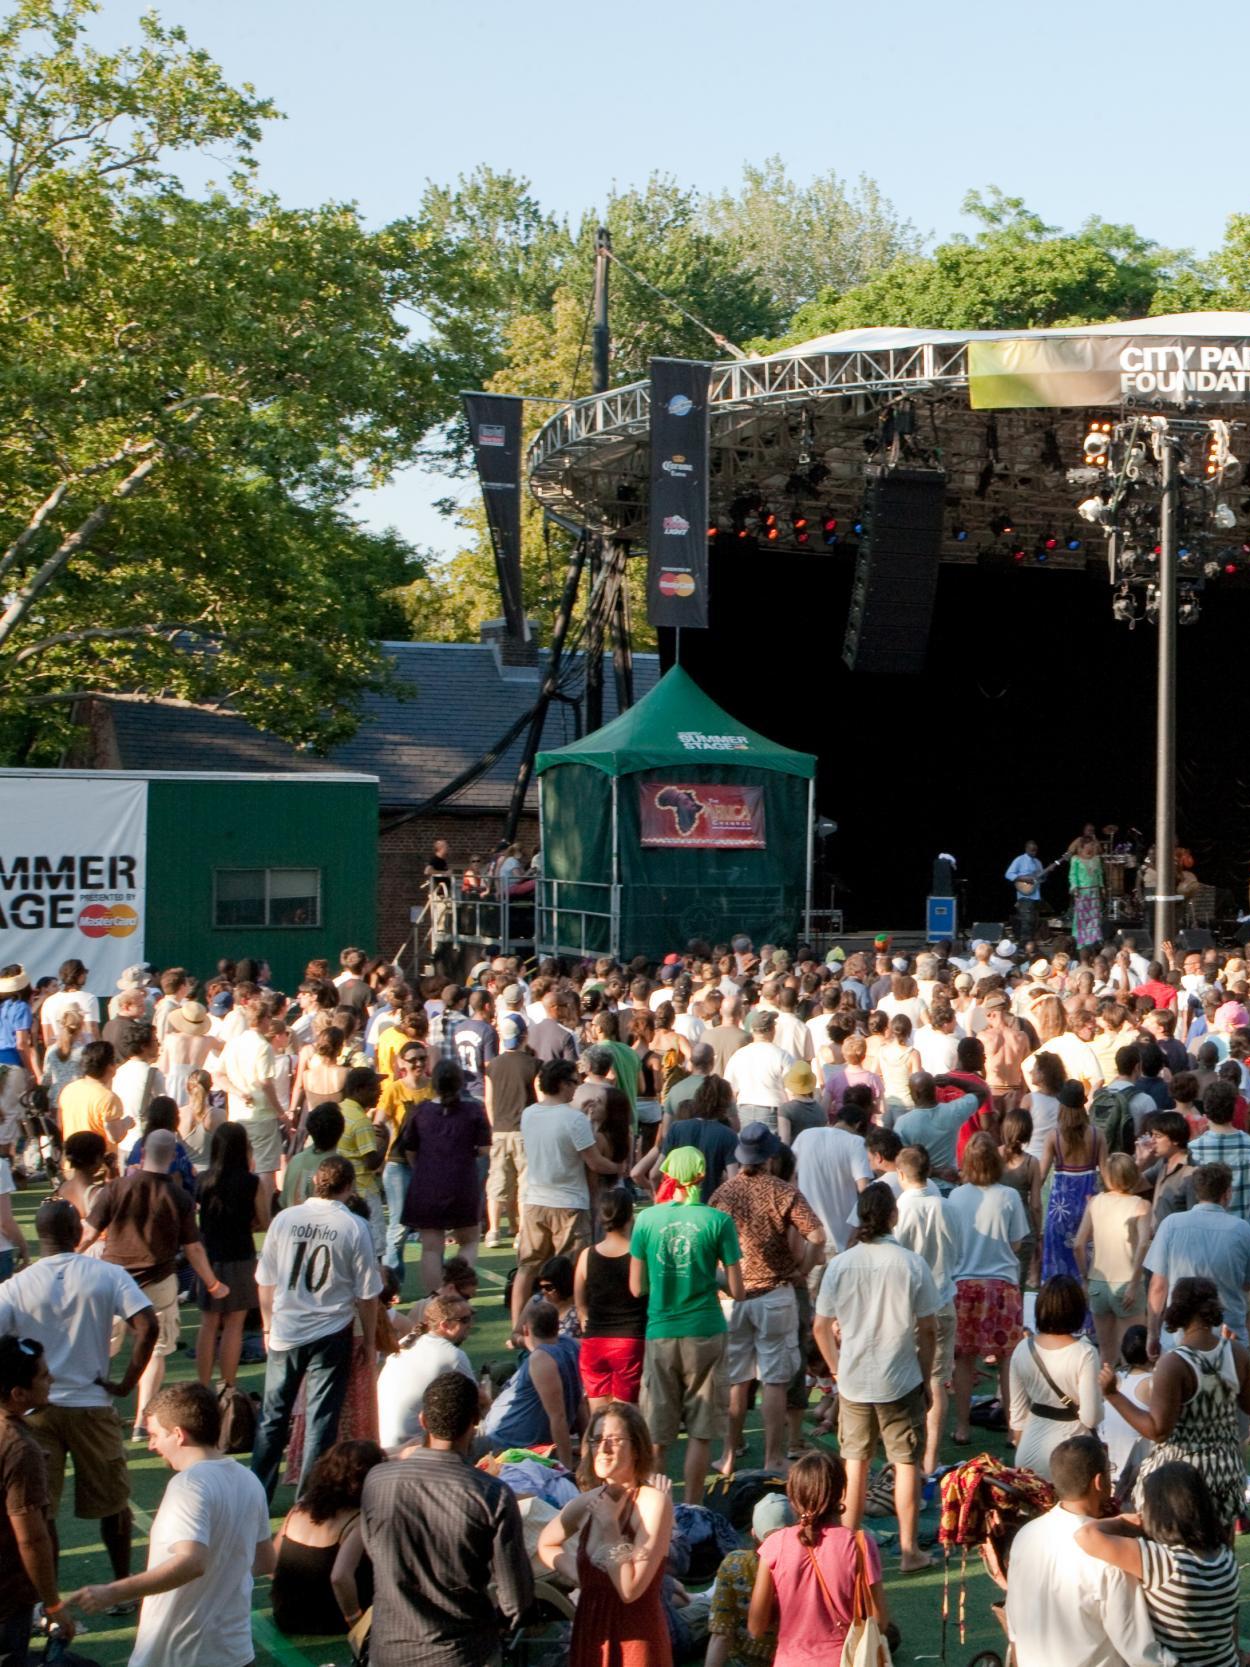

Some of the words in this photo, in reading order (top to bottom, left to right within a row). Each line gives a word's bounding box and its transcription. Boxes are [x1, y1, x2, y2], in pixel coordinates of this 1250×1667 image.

[1119, 346, 1196, 372] CITY
[677, 734, 750, 744] SUMMER
[683, 742, 736, 750] STAGE
[0, 893, 75, 929] GE
[78, 917, 138, 927] MasterCard
[288, 1240, 331, 1294] 10
